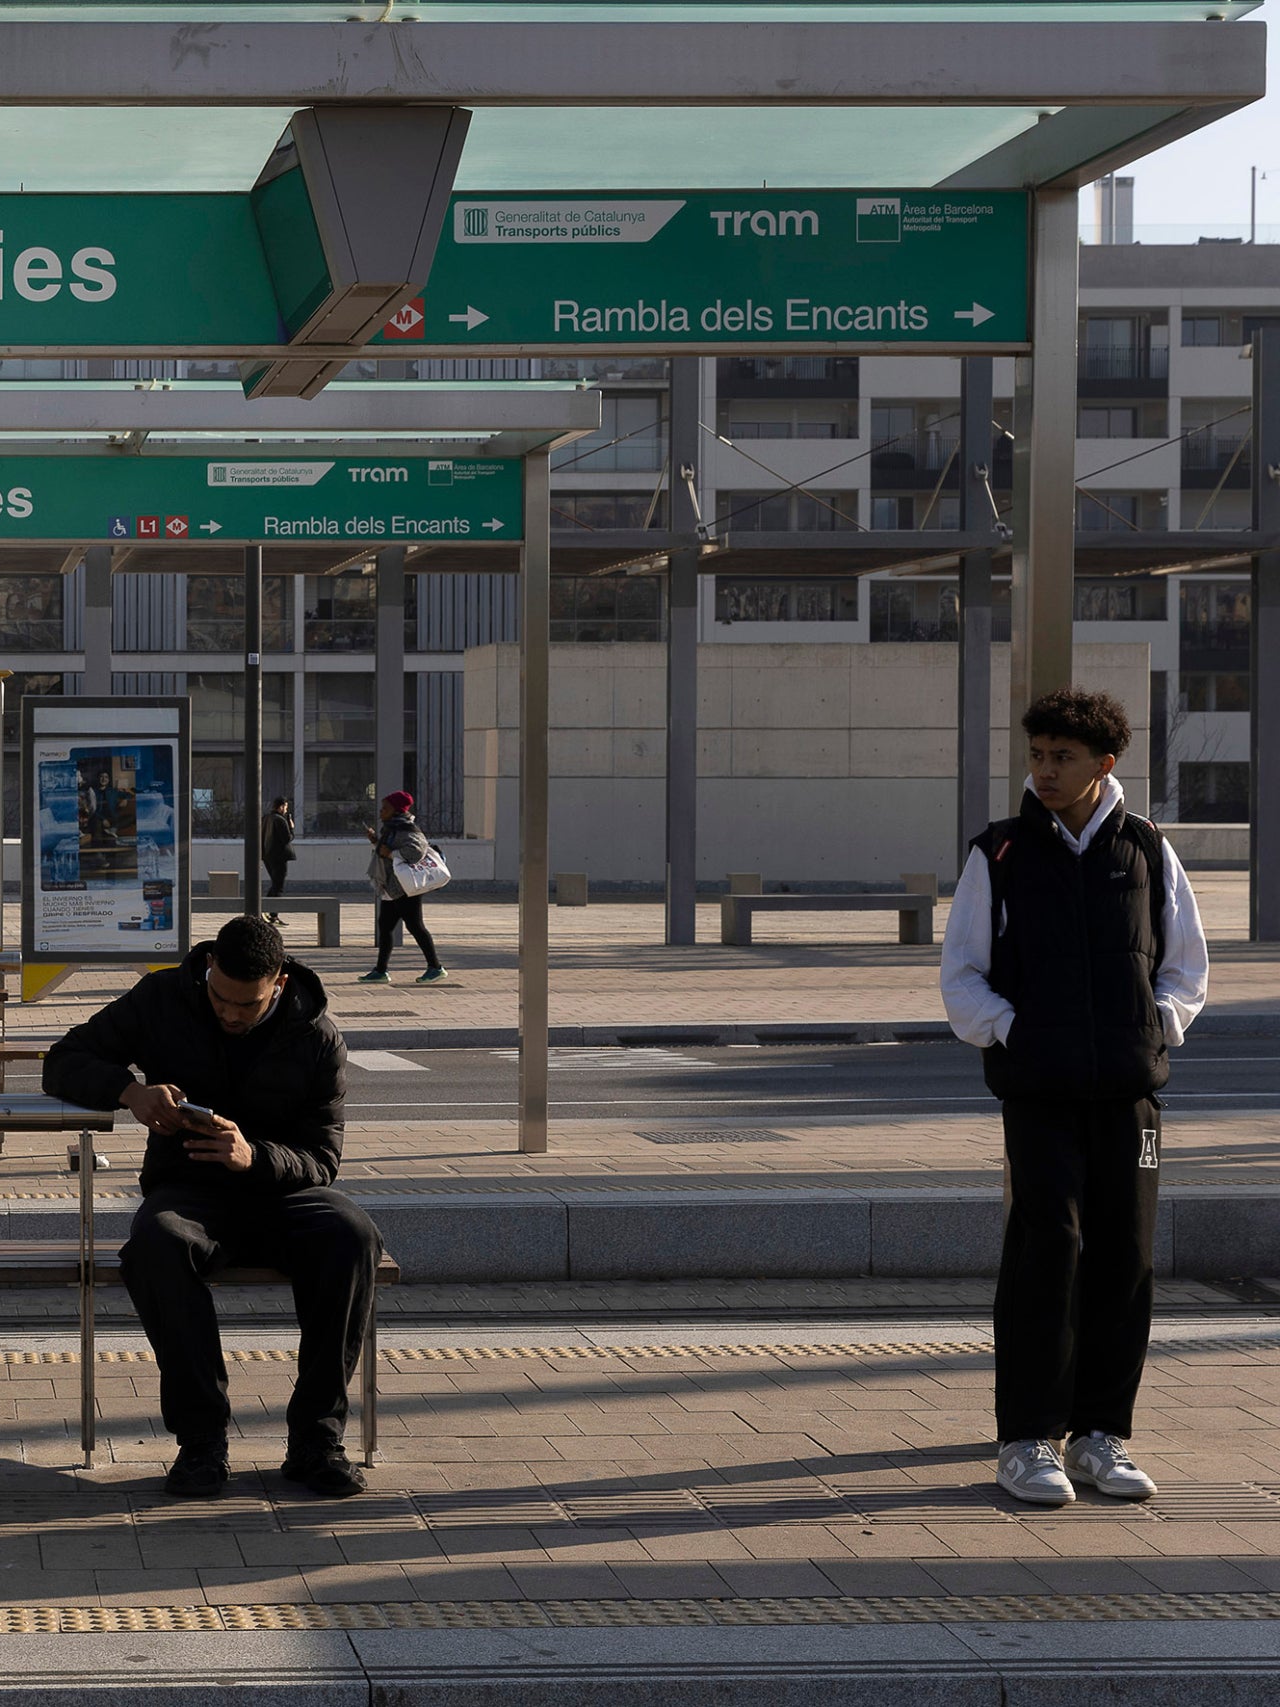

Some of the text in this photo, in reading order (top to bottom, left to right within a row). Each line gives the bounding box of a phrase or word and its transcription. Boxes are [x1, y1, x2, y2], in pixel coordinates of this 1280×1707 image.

[870, 204, 895, 215] ATM
[903, 202, 994, 215] Àrea de Barcelona
[495, 210, 646, 225] Generalitat de Catalunya
[946, 216, 977, 224] Transport
[495, 225, 621, 239] Transports públics
[903, 224, 941, 232] Metropolità
[396, 310, 412, 324] M
[554, 299, 928, 332] Rambla dels Encants
[230, 467, 312, 476] Generalitat de Catalunya
[272, 475, 299, 483] públics
[140, 520, 156, 533] L1
[172, 522, 182, 531] M
[264, 515, 470, 535] Rambla dels Encants
[1139, 1129, 1158, 1168] A
